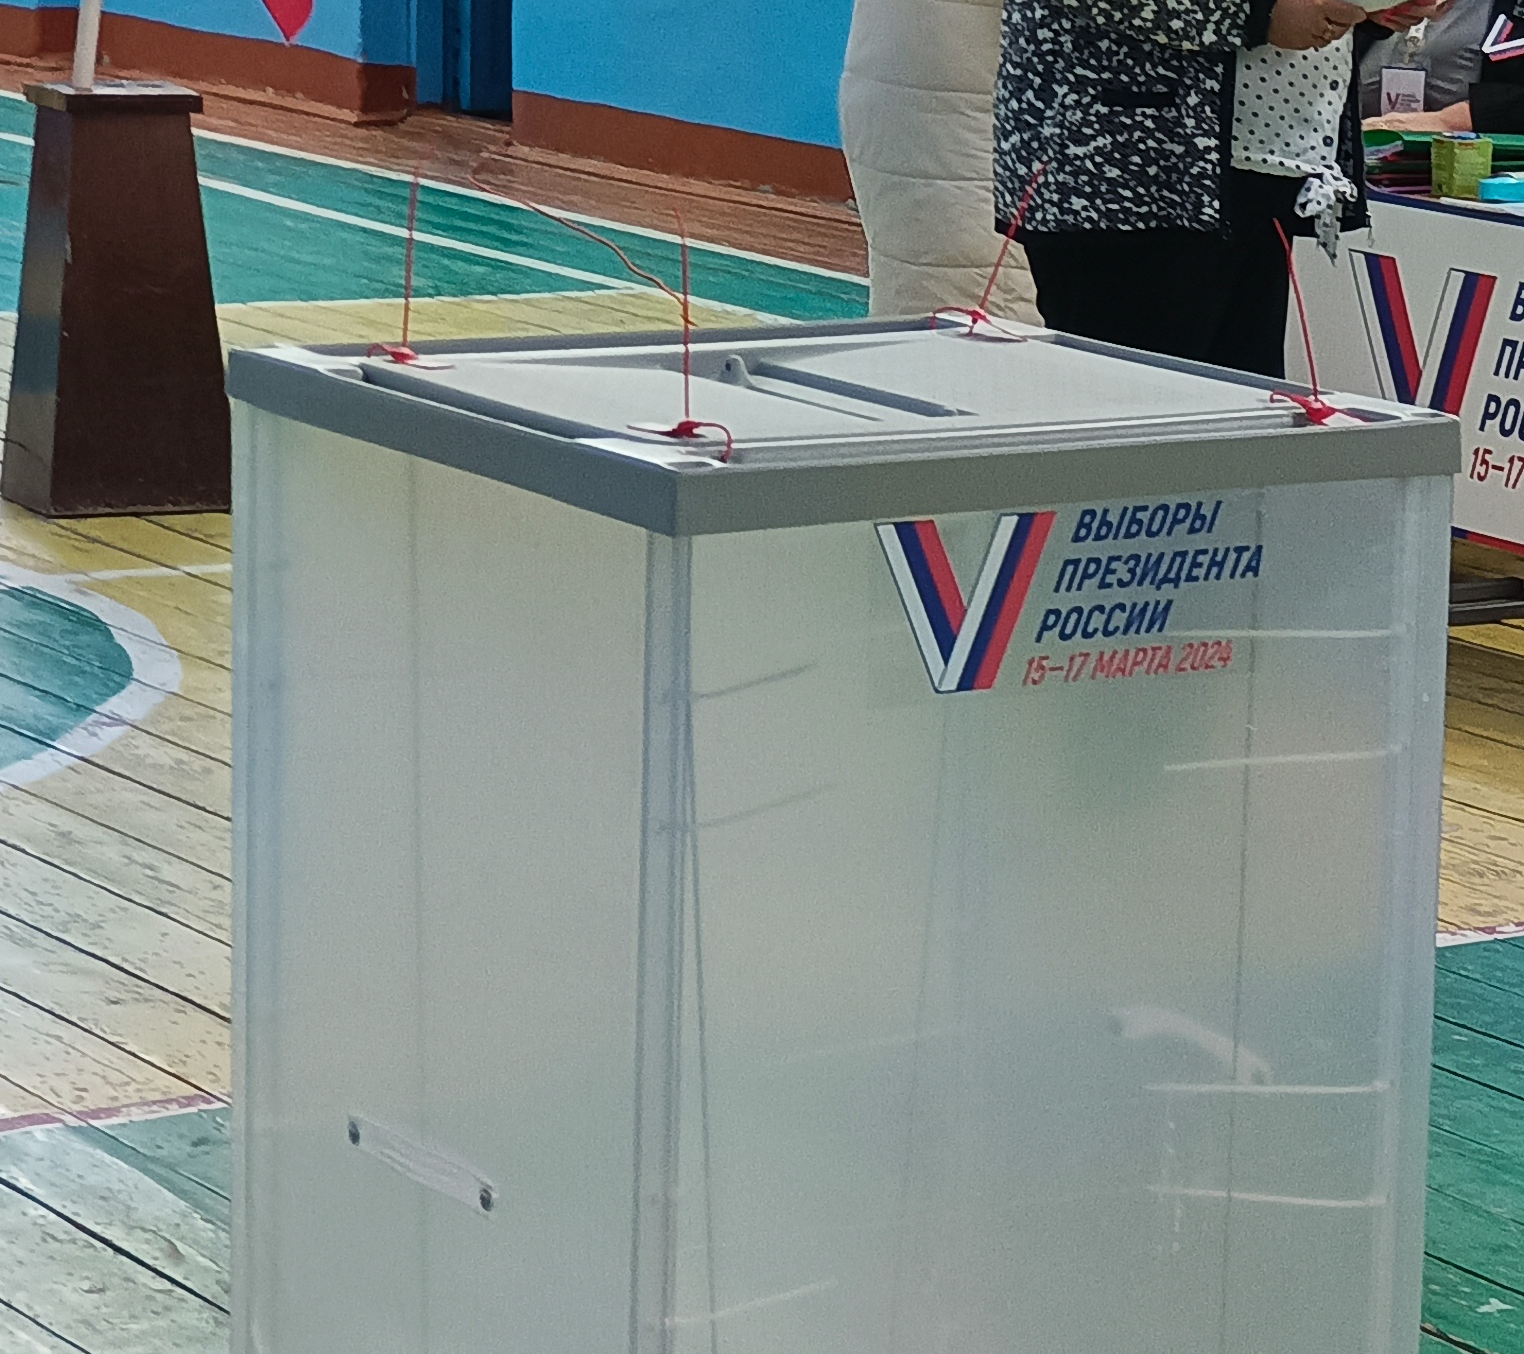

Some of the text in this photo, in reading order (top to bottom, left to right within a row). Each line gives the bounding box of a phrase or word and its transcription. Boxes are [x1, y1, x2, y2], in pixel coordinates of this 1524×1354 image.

[1071, 500, 1224, 544] ВЫБОРЫ
[1053, 545, 1263, 593] ПРЕЗИДЕНТА
[1035, 599, 1174, 643] РОССИИ
[1090, 645, 1172, 680] МАРТА
[1174, 640, 1233, 673] 2024
